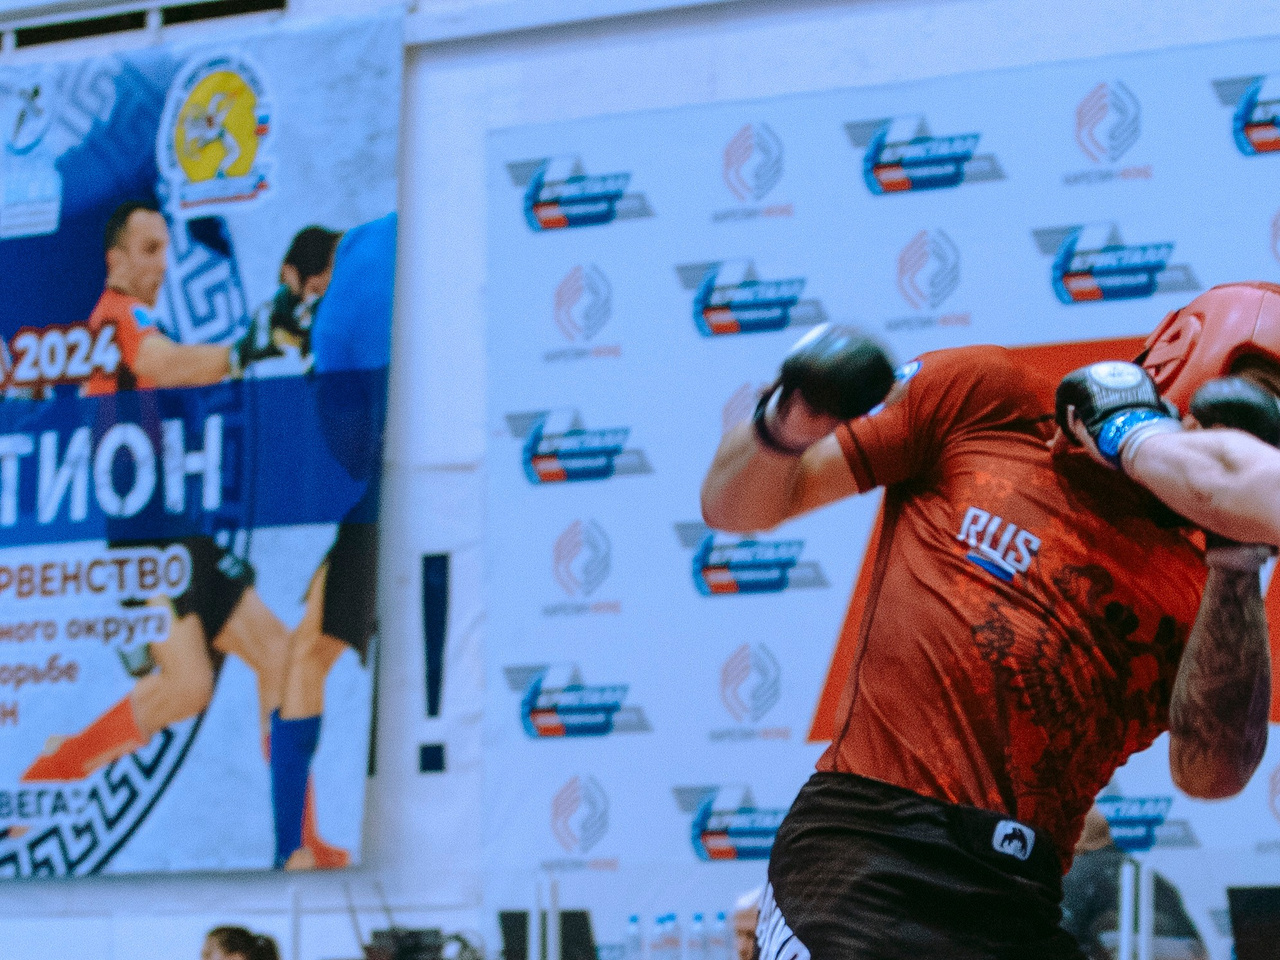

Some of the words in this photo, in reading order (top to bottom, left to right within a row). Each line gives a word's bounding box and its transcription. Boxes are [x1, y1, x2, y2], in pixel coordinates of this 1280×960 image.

[14, 325, 120, 380] 2024
[0, 414, 223, 527] ТИОН
[956, 506, 1042, 573] RUS
